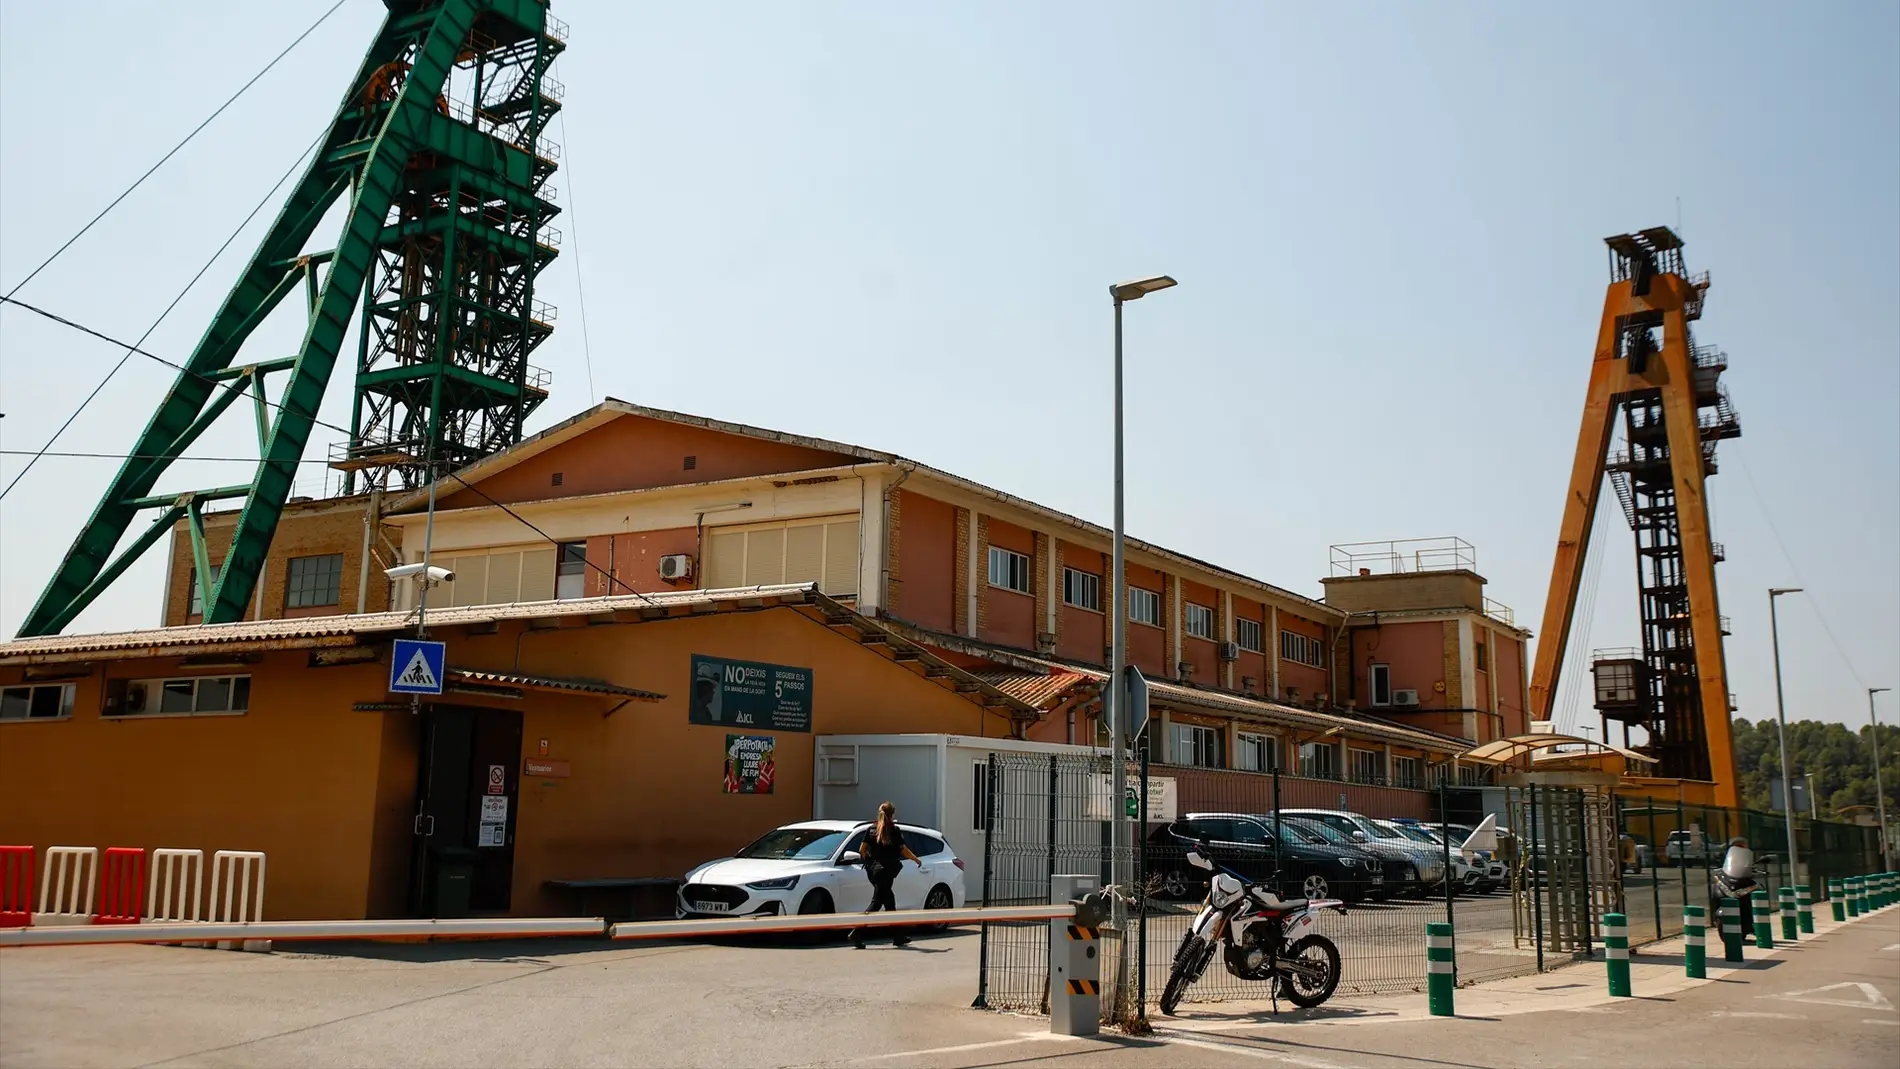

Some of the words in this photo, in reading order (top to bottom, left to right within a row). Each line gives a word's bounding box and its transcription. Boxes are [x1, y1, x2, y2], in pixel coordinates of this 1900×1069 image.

[725, 664, 745, 684] NO
[745, 668, 766, 679] DEIXIS
[775, 671, 795, 680] SEGUEIX
[775, 681, 782, 698] 5
[784, 681, 804, 691] PASSOS
